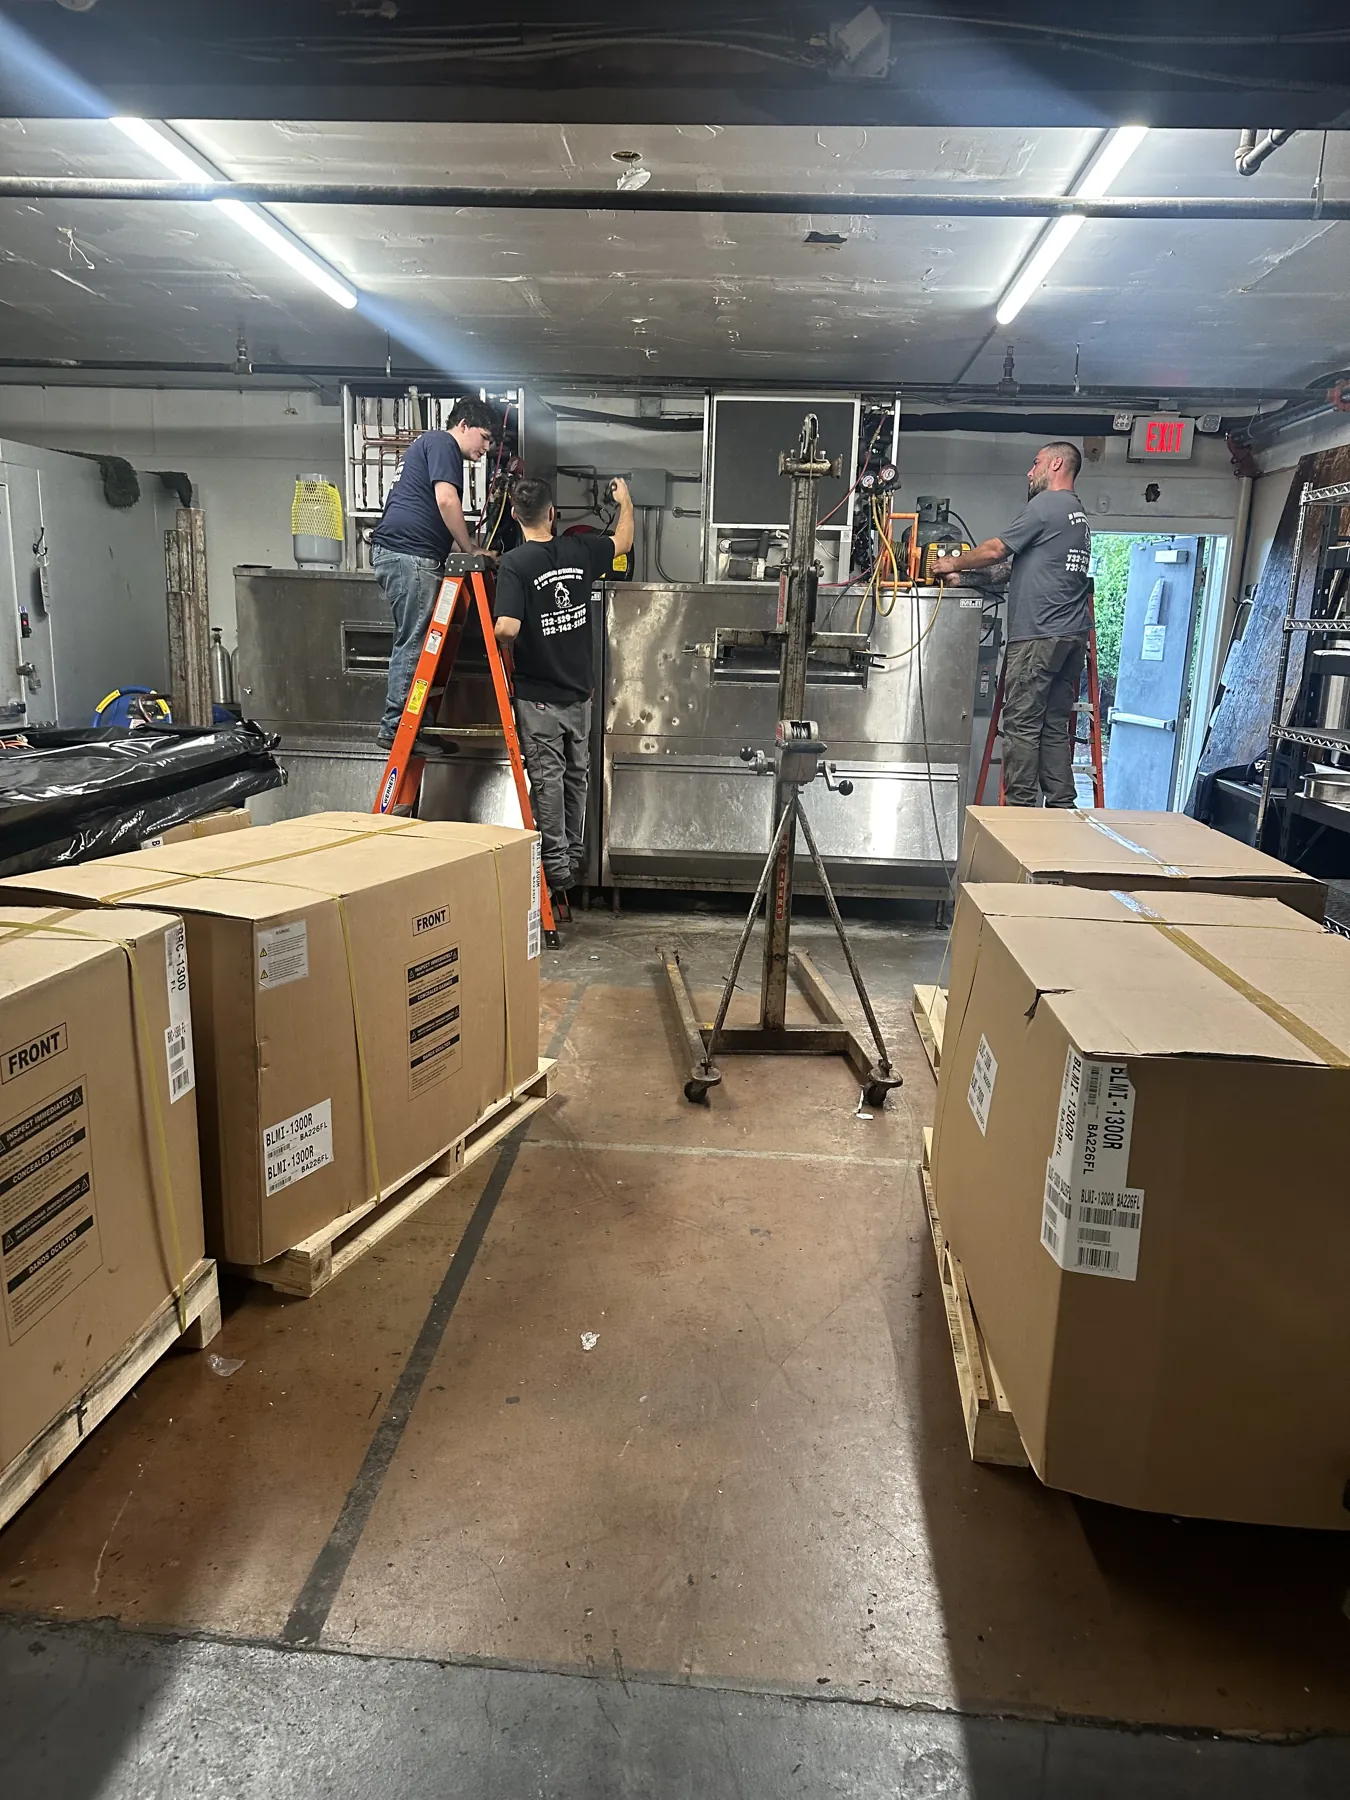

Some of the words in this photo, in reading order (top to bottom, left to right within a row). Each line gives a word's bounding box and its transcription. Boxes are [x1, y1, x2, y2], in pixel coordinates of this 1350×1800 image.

[1145, 421, 1186, 453] EXIT
[384, 776, 395, 804] WERNER
[416, 909, 446, 932] FRONT
[8, 1031, 60, 1075] FRONT
[1064, 1055, 1082, 1142] BLMI-1300R
[6, 1119, 34, 1142] INSPECT
[34, 1093, 73, 1124] IMMEDIATELY
[265, 1111, 313, 1147] BLMI-1300R
[299, 1120, 328, 1141] BA226FL
[12, 1153, 50, 1184] CONCEALED
[50, 1136, 75, 1158] DAMAGE
[267, 1145, 314, 1180] BLMI-1300R
[301, 1153, 329, 1173] BA226FL
[1083, 1123, 1099, 1175] BA226FL
[1080, 1188, 1115, 1207] BLMI-1300R
[1116, 1192, 1141, 1210] BA226FL
[29, 1252, 50, 1274] DAÑOS
[50, 1230, 77, 1256] OCULTOS
